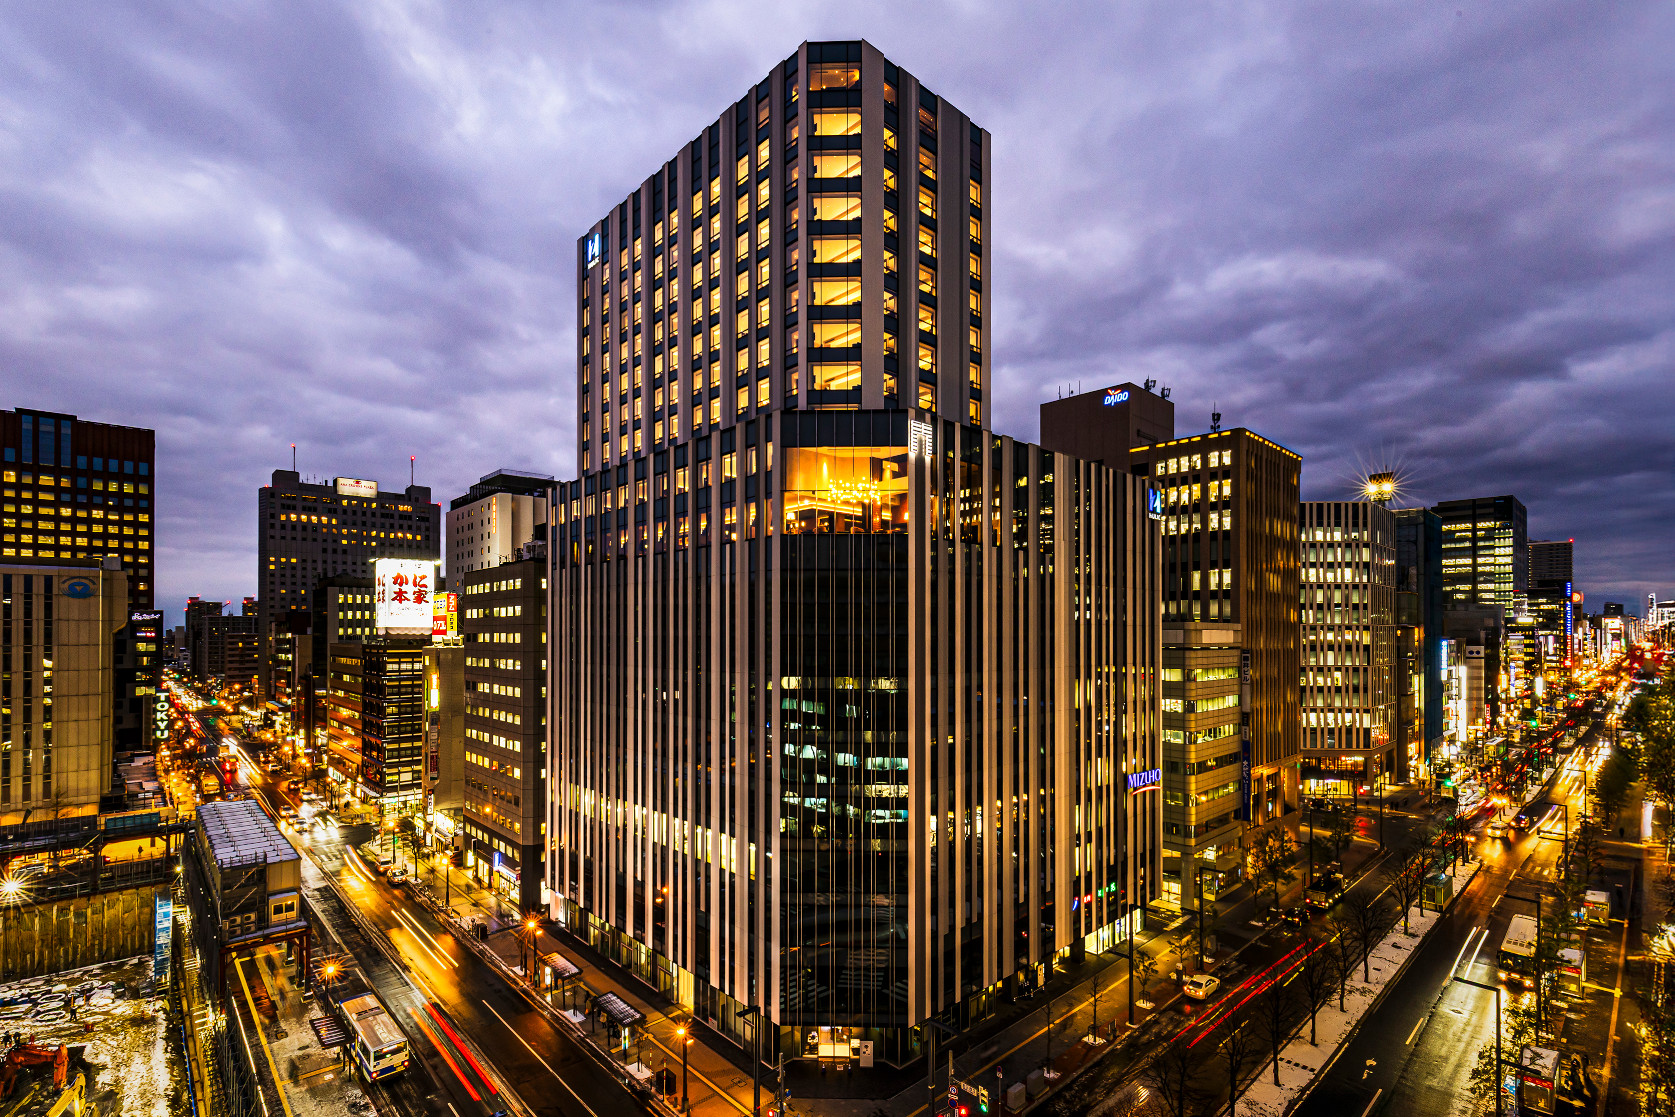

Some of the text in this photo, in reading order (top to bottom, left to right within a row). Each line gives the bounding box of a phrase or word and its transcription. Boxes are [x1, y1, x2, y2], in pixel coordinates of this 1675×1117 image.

[1104, 390, 1129, 406] DAIDO
[391, 572, 428, 588] かに
[391, 588, 429, 605] 本家
[156, 692, 169, 739] TOKYU
[1128, 768, 1162, 789] MIZUHO
